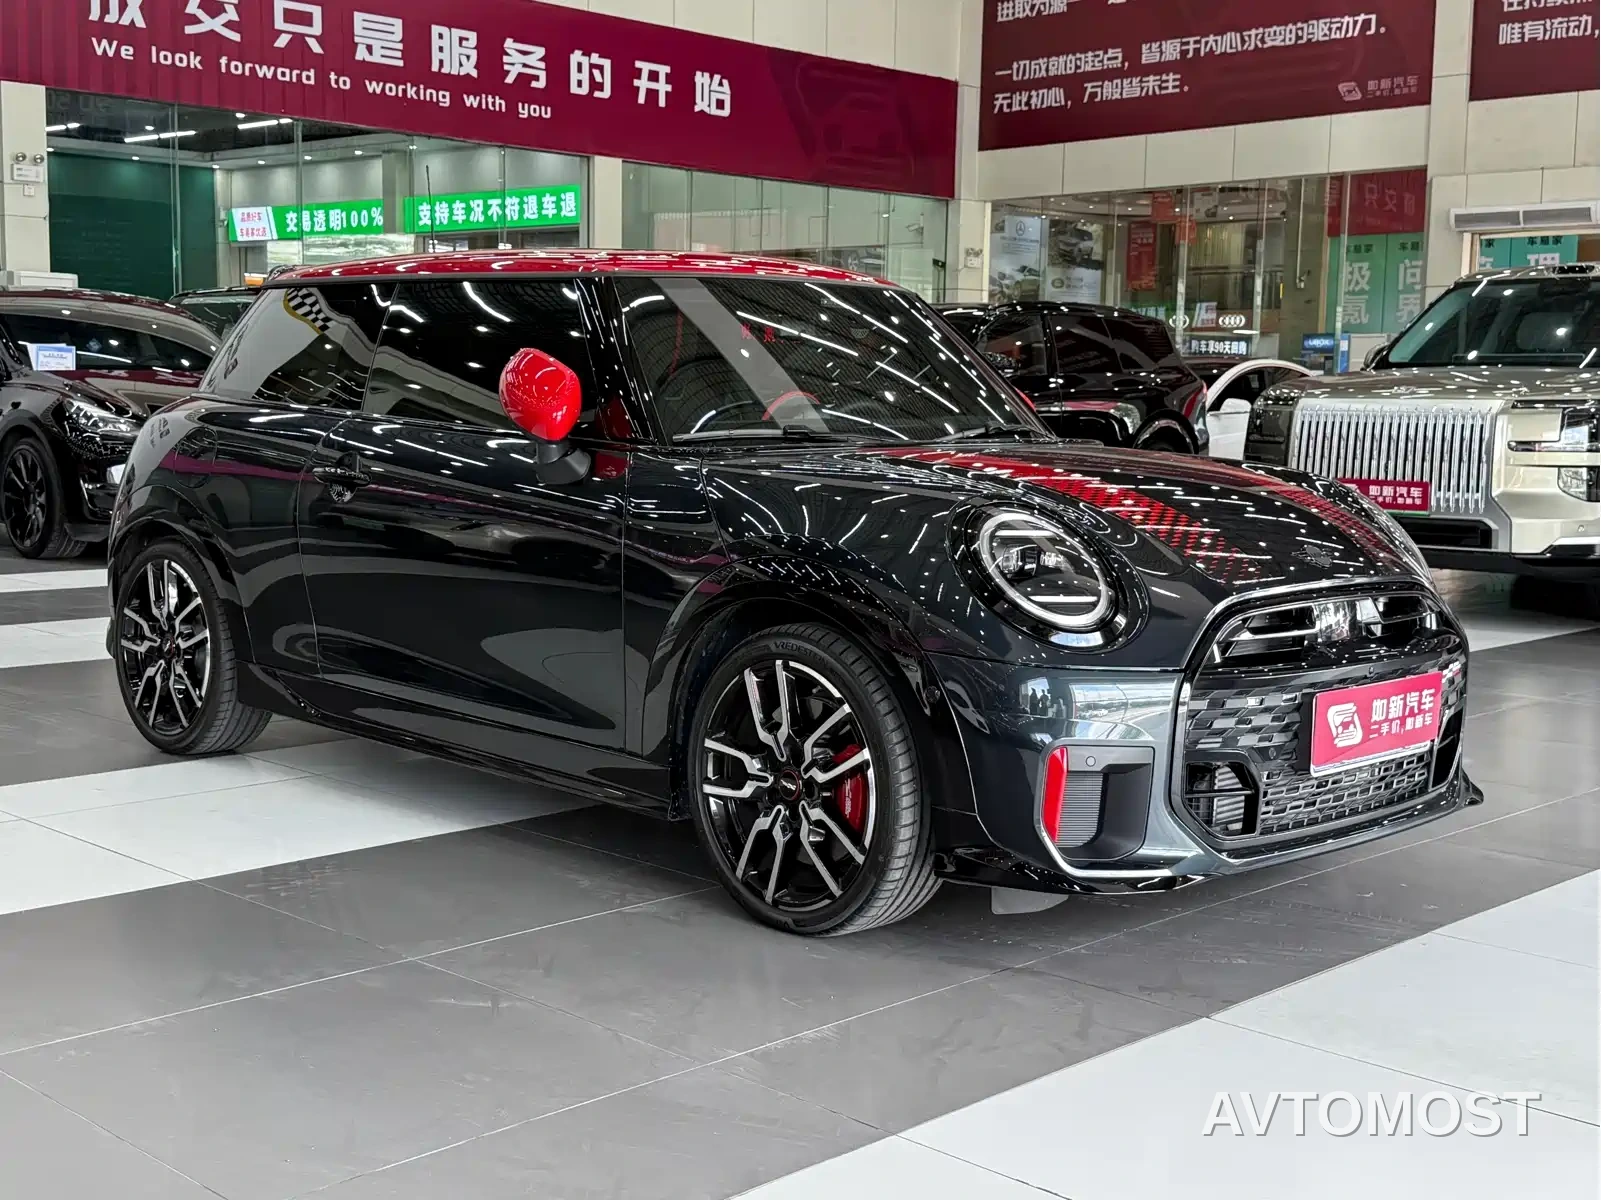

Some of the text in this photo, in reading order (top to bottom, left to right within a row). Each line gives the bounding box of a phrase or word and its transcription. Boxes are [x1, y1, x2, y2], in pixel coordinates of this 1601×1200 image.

[91, 37, 551, 119] We look forward to working with you
[285, 206, 384, 233] 交易透明100%
[418, 191, 577, 226] 支持车况不符退车退
[1371, 688, 1435, 723] 如新汽车
